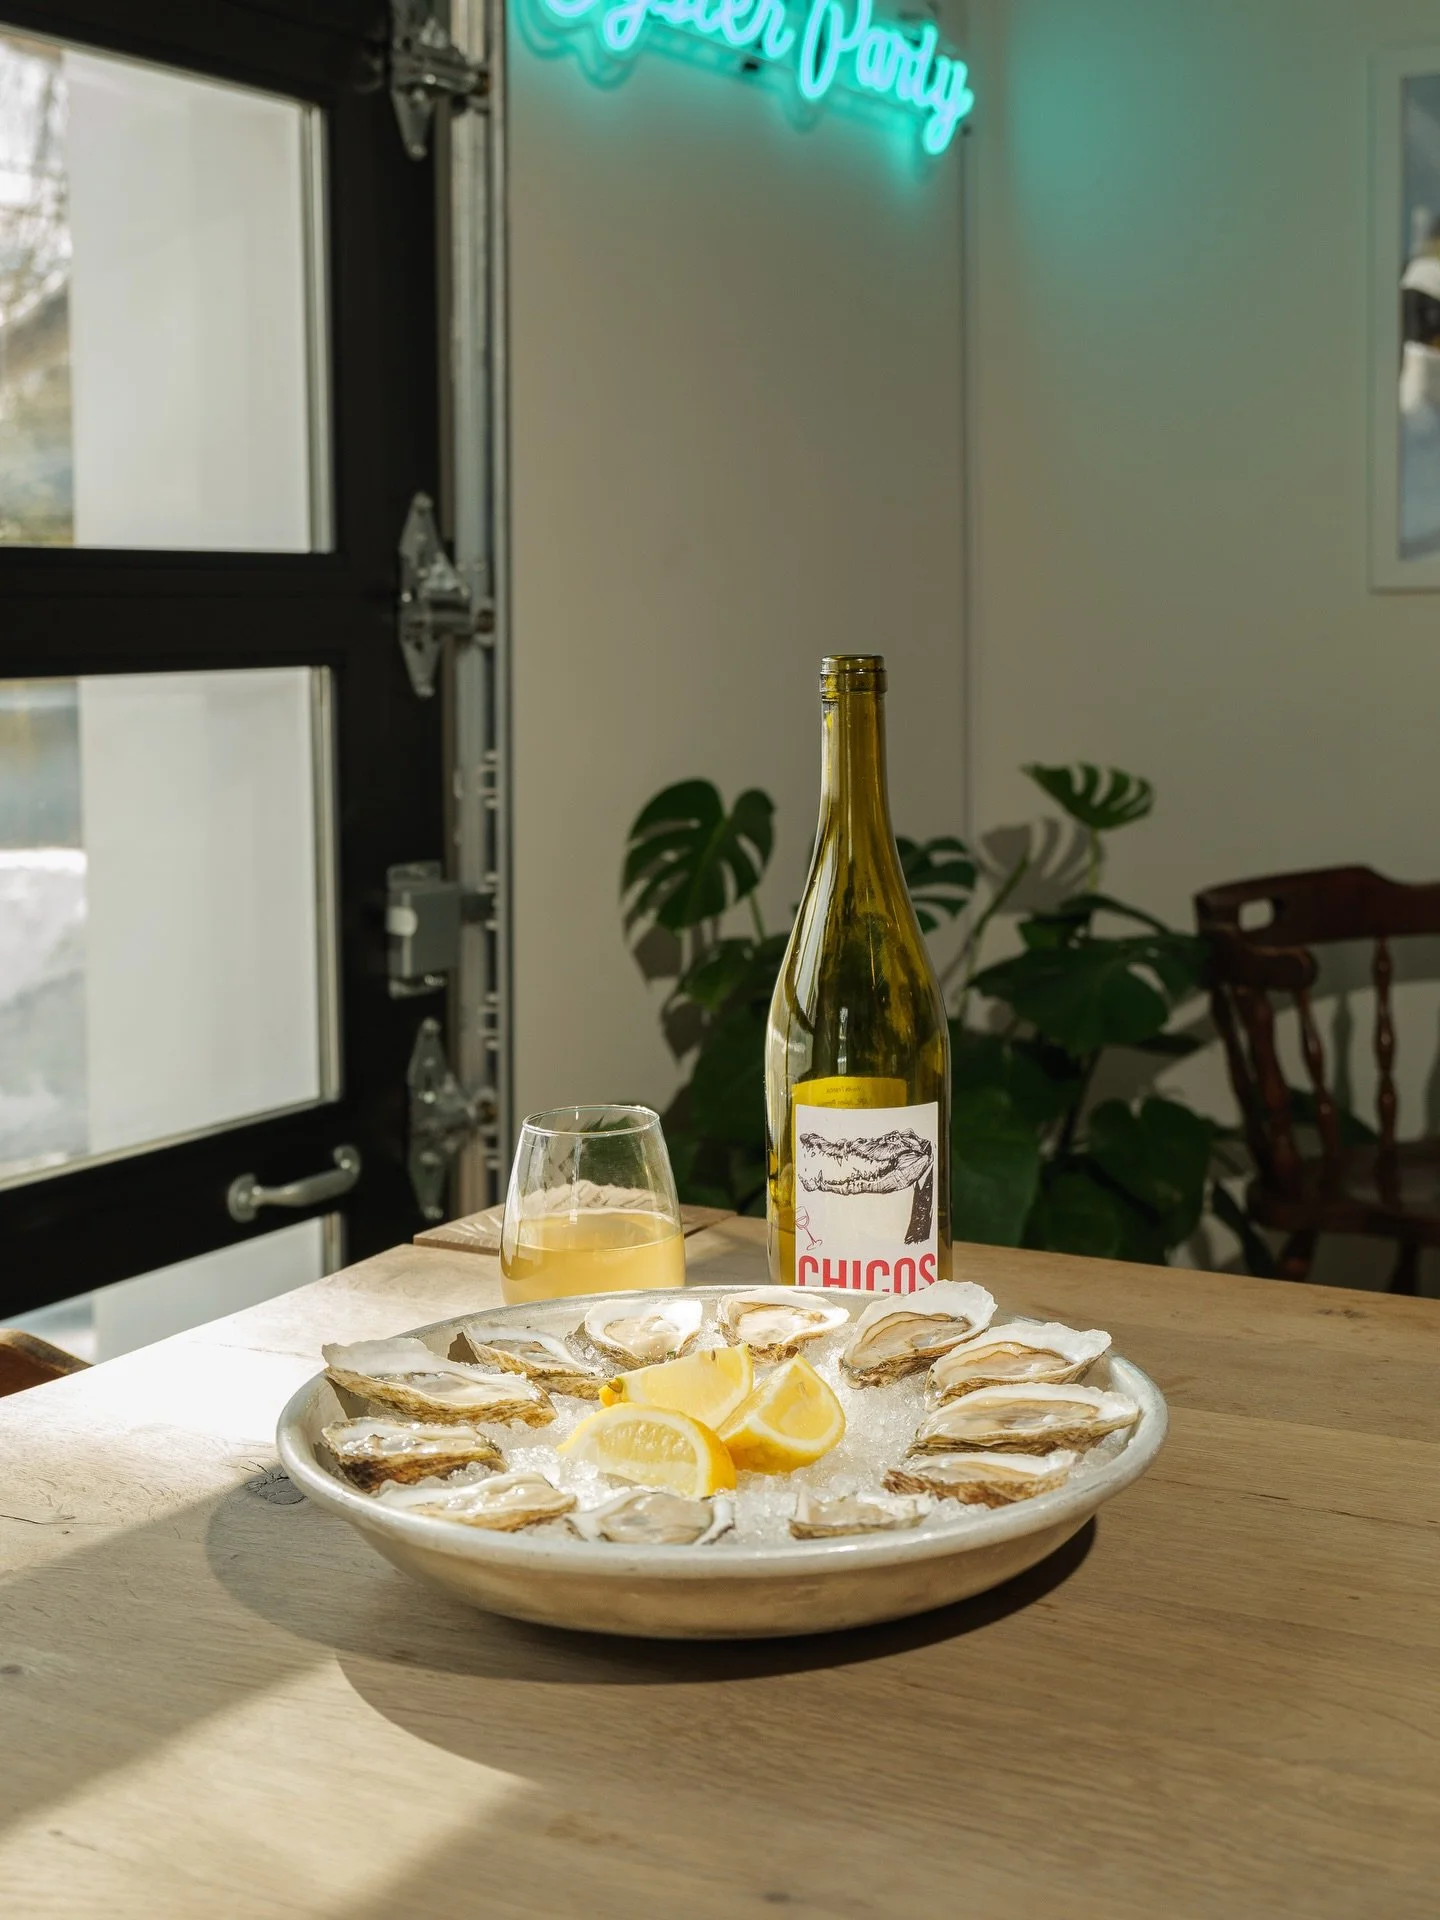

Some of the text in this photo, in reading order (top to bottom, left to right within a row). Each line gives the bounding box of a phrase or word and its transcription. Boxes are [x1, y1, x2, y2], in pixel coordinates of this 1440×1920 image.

[545, 0, 975, 155] yer Party
[798, 1253, 936, 1294] CHICOS
